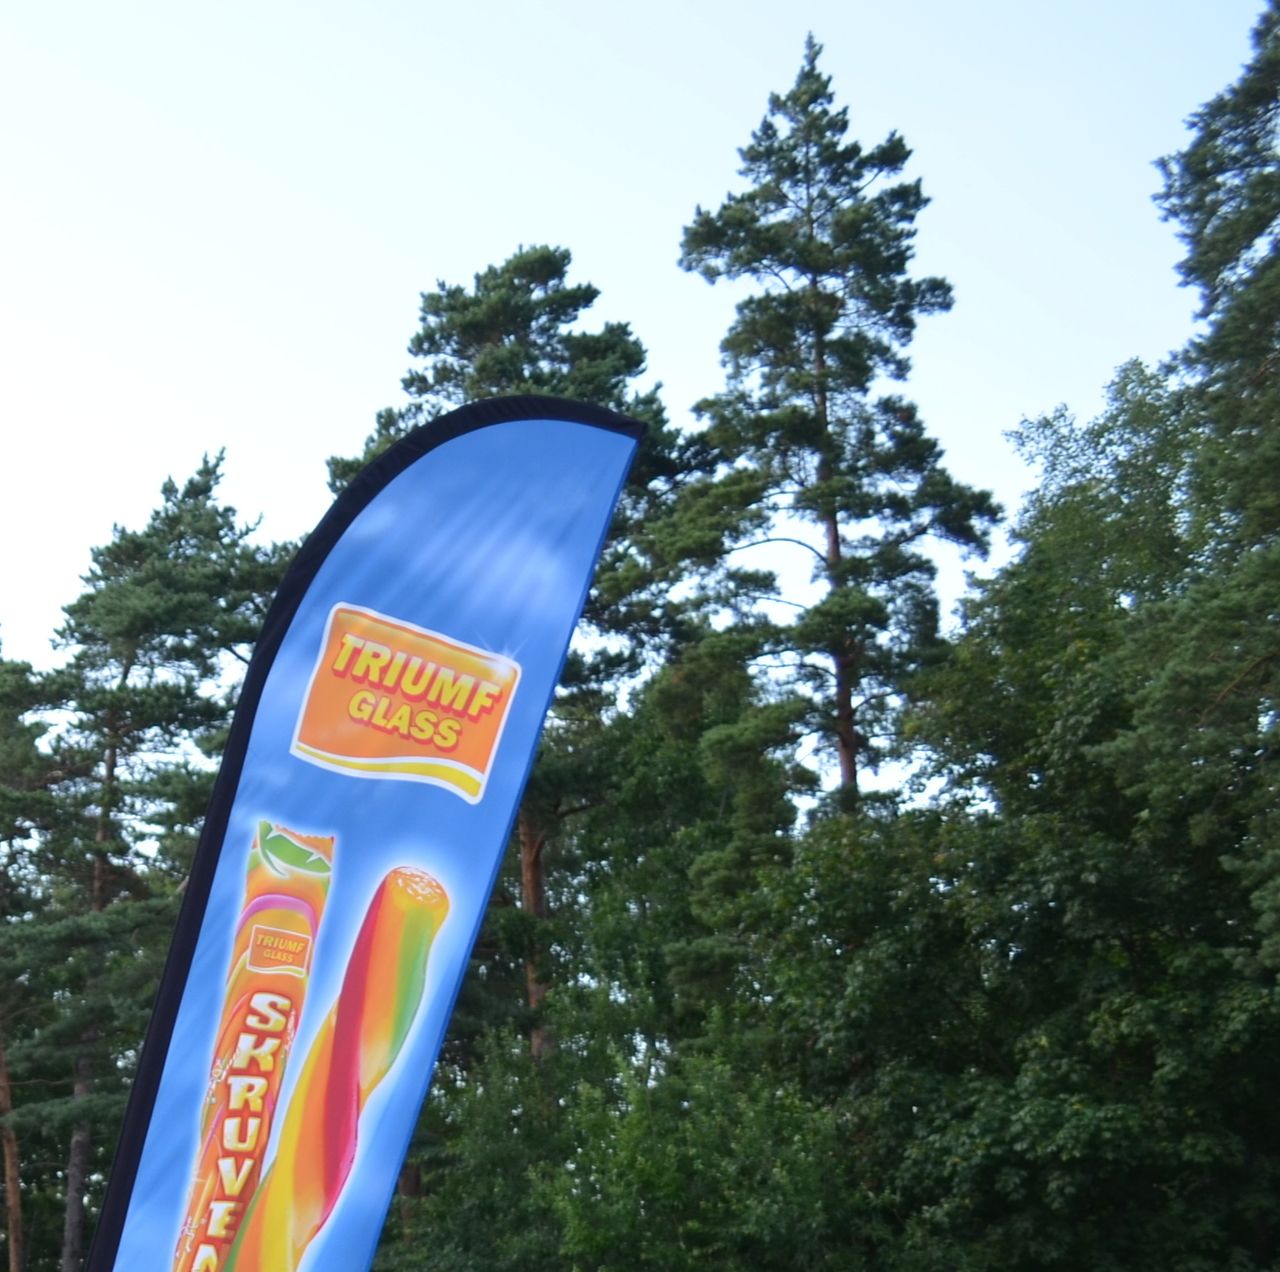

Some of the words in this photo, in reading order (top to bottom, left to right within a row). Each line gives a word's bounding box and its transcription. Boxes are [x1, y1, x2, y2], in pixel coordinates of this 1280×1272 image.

[332, 633, 502, 722] TRIUMF
[348, 689, 462, 752] GLASS
[256, 934, 306, 954] TRIUMF
[263, 949, 293, 963] GLASS
